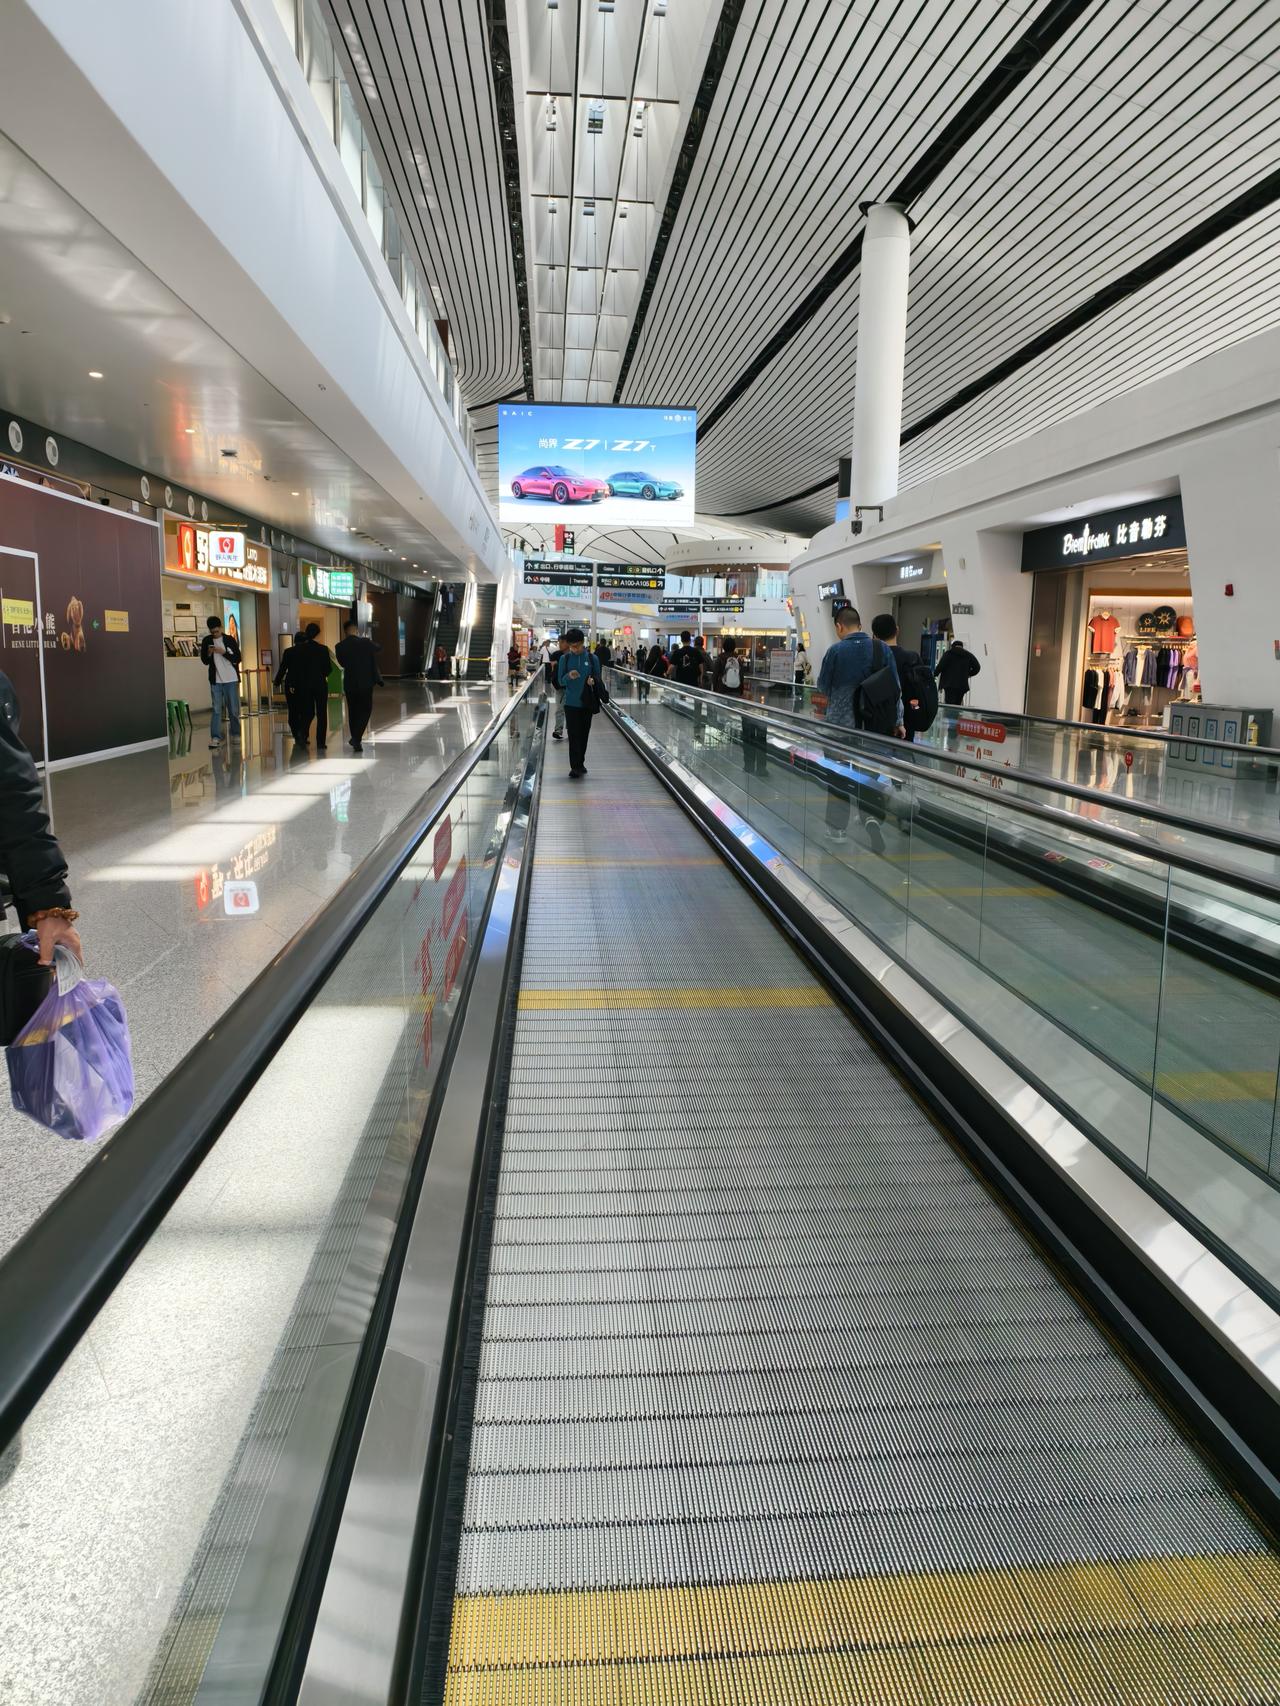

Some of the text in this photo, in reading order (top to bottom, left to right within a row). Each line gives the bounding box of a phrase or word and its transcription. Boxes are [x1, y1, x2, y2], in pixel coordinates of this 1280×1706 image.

[538, 438, 558, 449] 尚界
[561, 438, 601, 450] Z7
[1116, 514, 1167, 545] 比音勒芬
[620, 579, 649, 587] A100-A105
